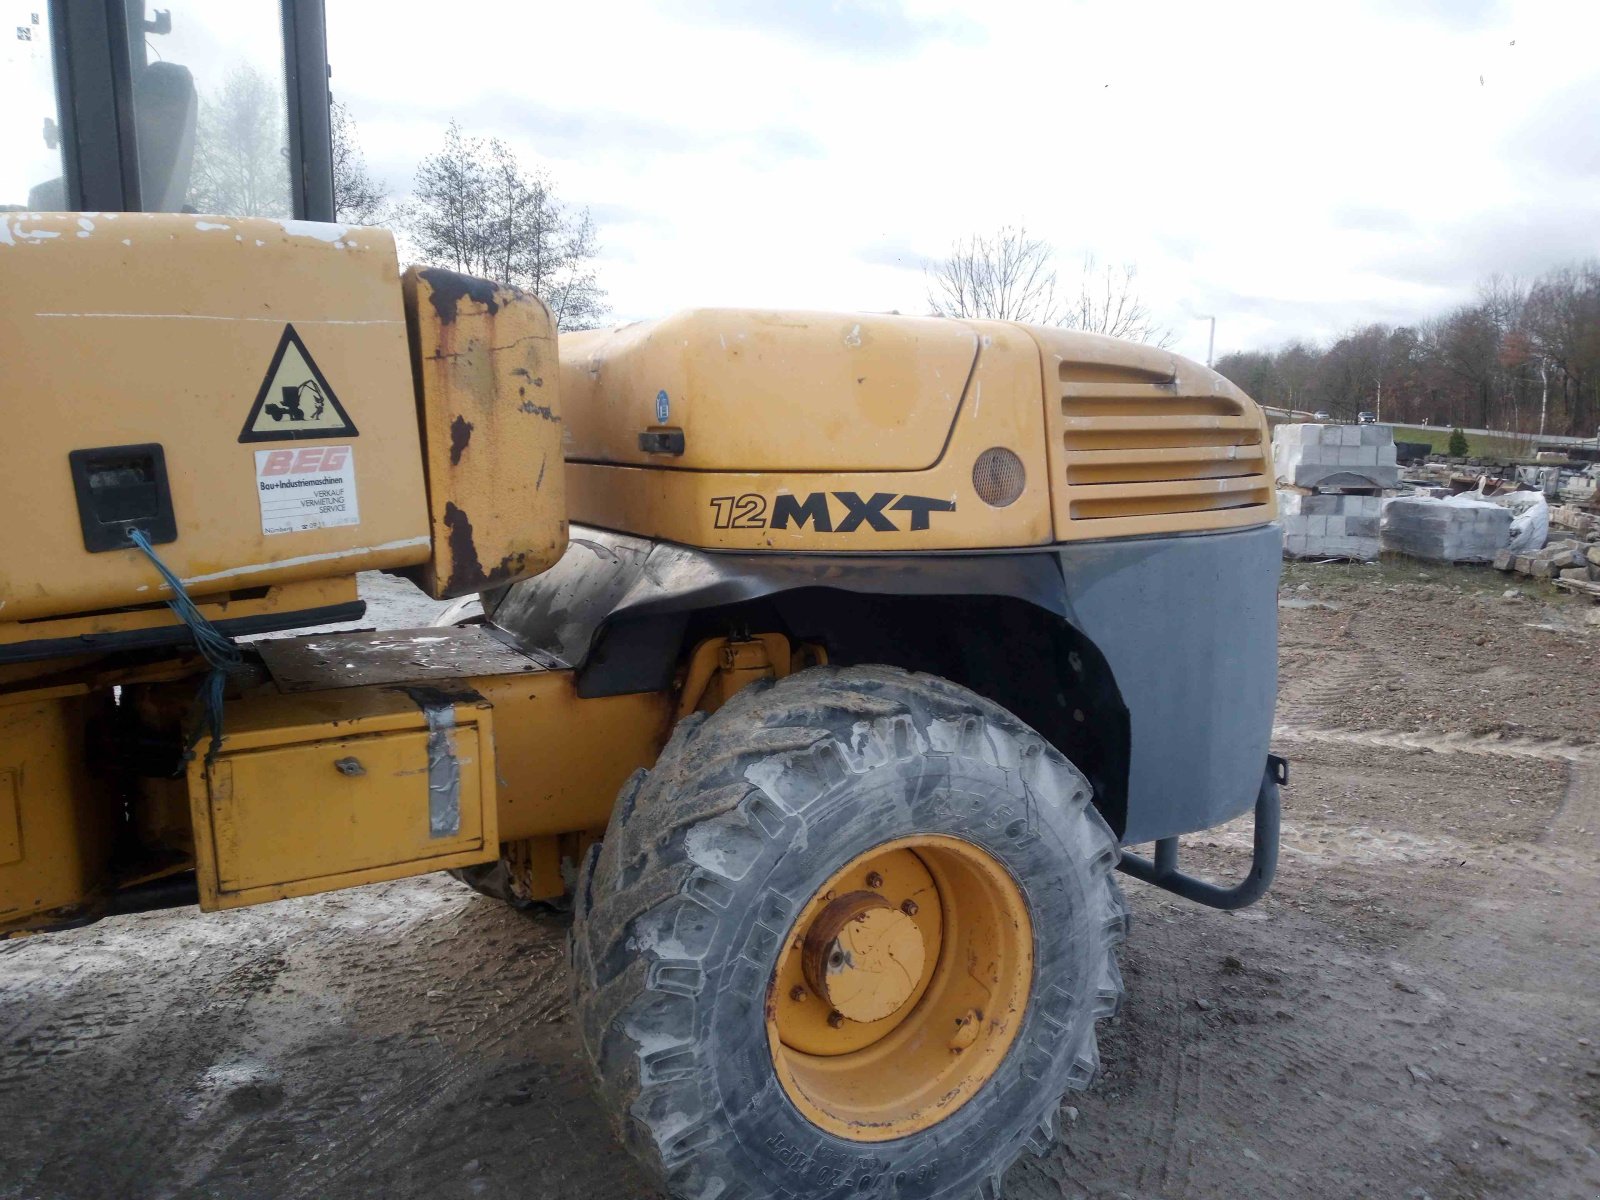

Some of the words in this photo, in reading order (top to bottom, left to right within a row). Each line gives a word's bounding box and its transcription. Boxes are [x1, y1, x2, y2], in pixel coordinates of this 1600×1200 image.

[261, 447, 349, 476] BEG
[313, 489, 344, 498] VERKAUF
[300, 496, 345, 507] VERMIETUNG
[319, 504, 346, 514] SERVICE
